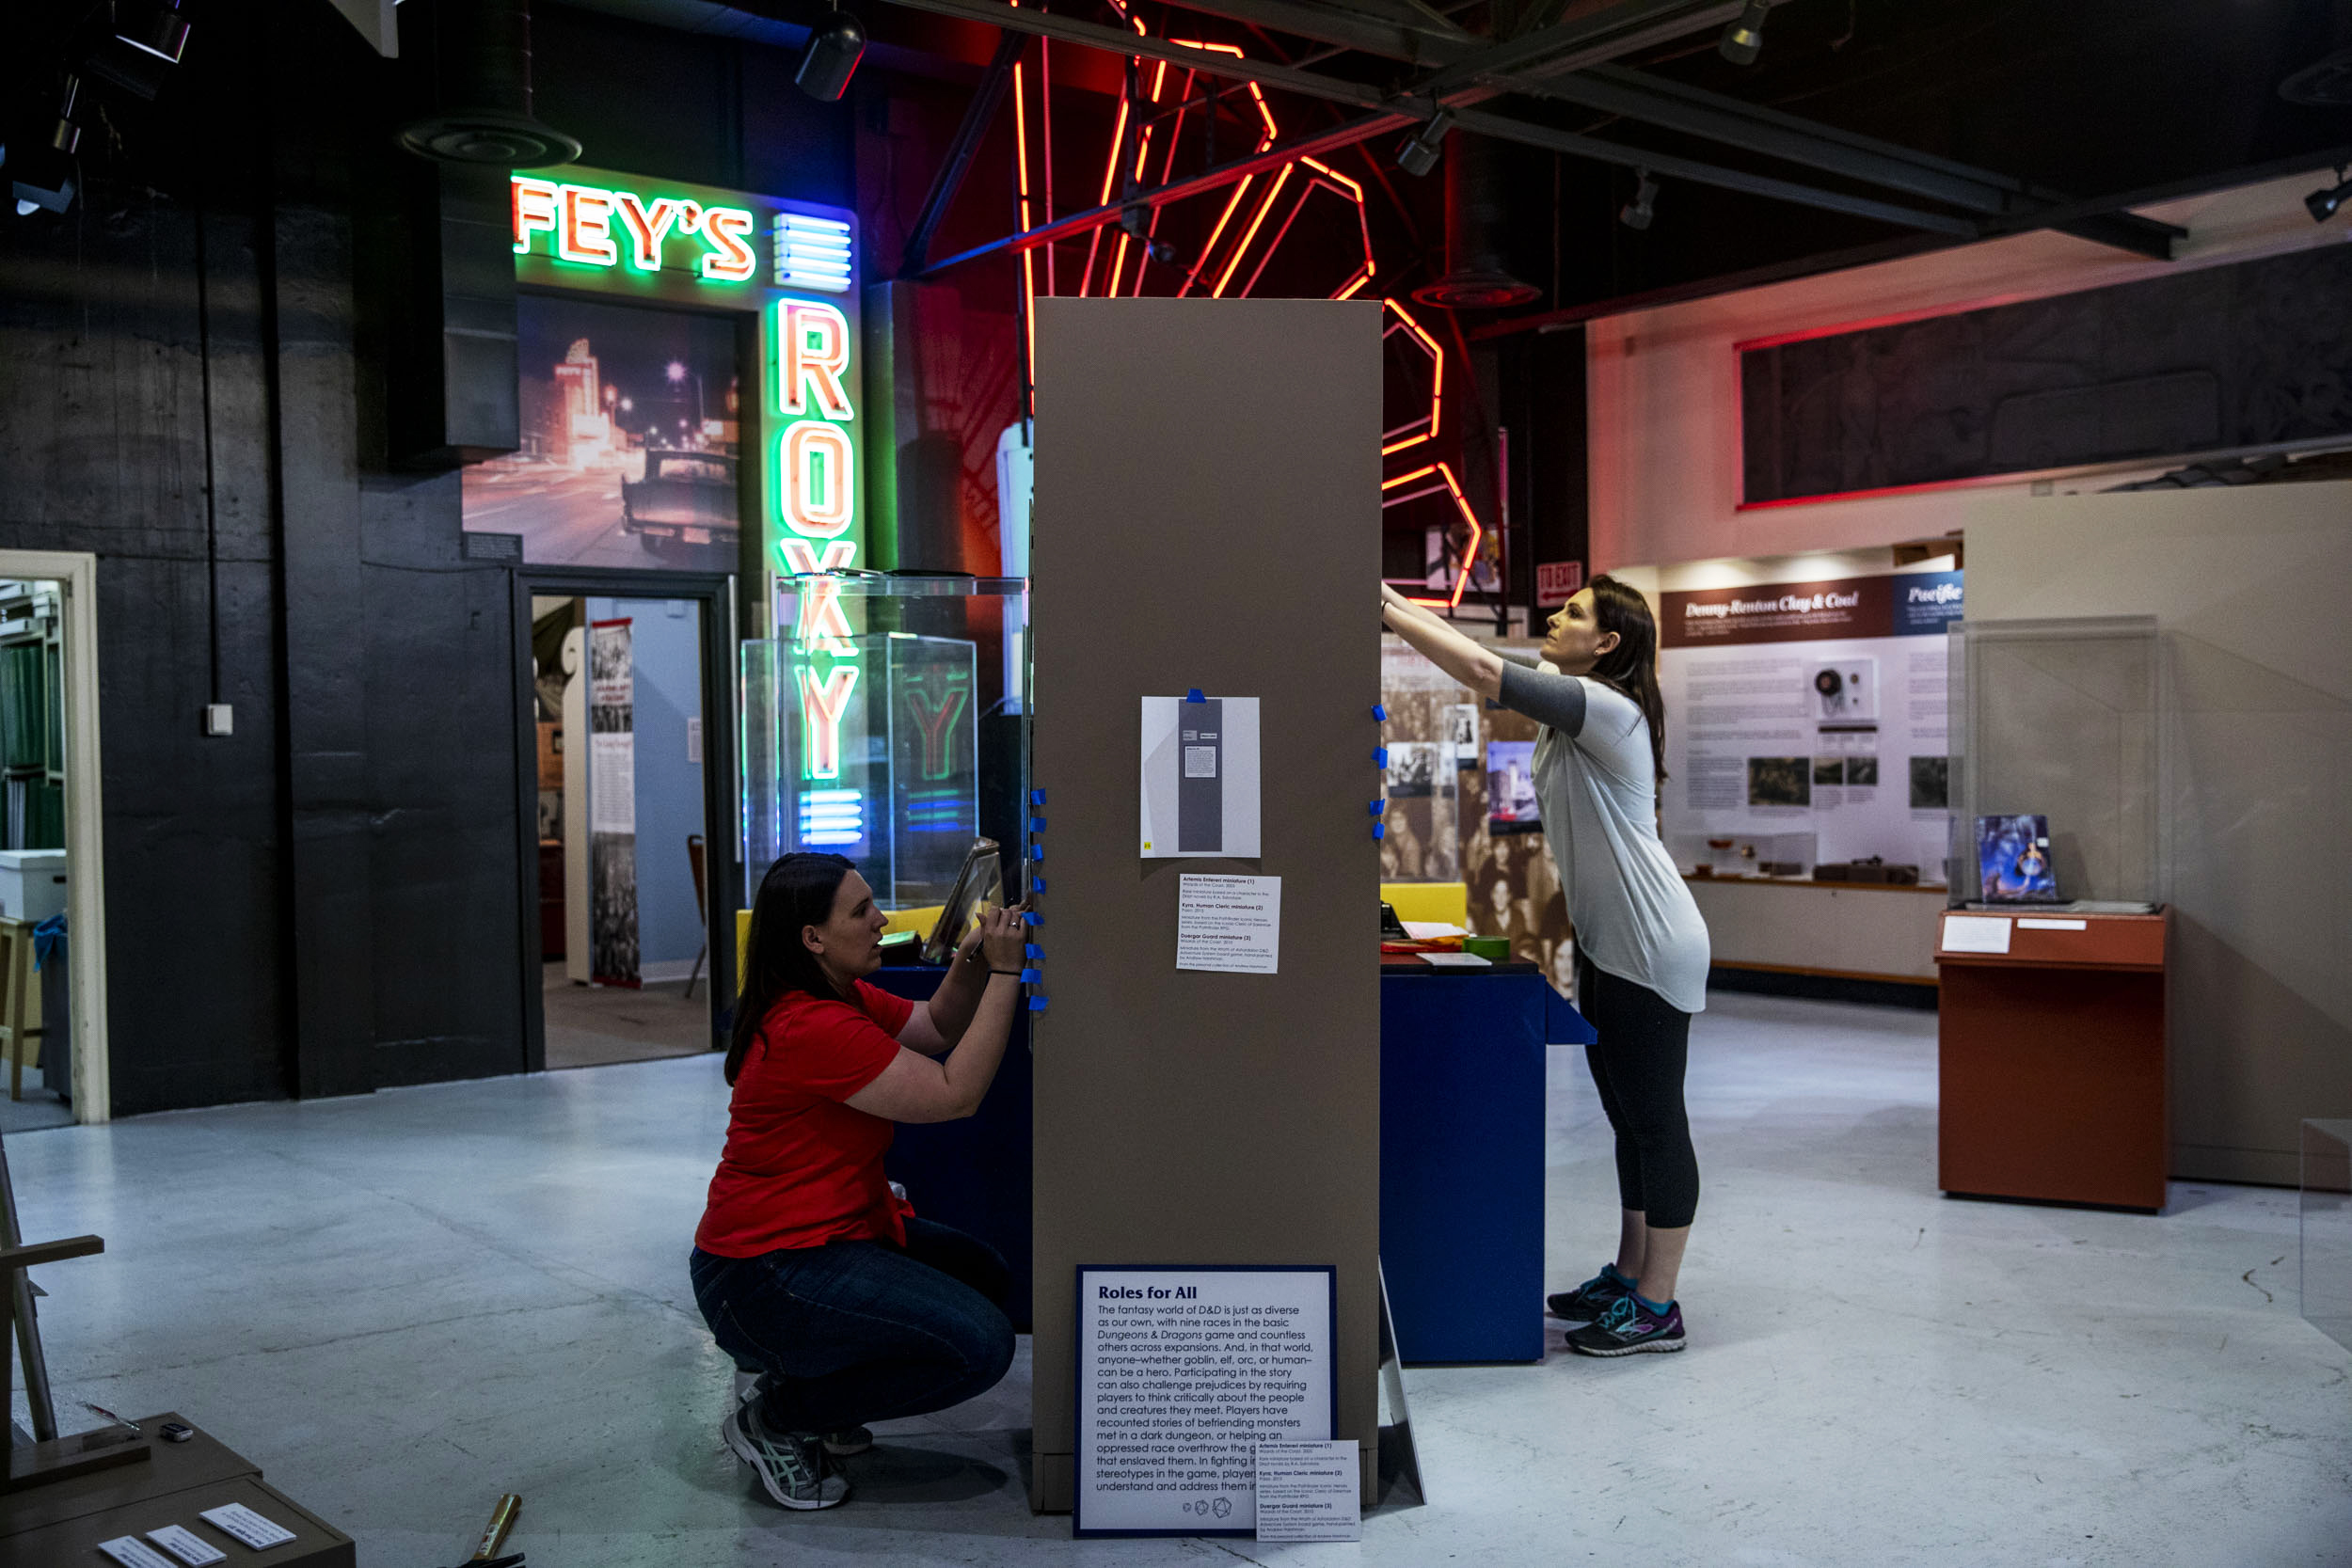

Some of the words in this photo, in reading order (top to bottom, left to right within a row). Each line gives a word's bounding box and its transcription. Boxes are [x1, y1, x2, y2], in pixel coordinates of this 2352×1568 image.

[778, 297, 860, 780] ROXY
[1556, 564, 1579, 587] EXIT
[1779, 594, 1811, 613] Clay
[1825, 591, 1859, 608] Coal
[1099, 1286, 1143, 1299] Roles
[1147, 1286, 1172, 1299] for
[1175, 1286, 1197, 1299] All
[1098, 1305, 1116, 1314] The
[1118, 1305, 1154, 1316] fantasy
[1156, 1305, 1184, 1315] world
[1186, 1305, 1197, 1315] of
[1198, 1305, 1222, 1315] D&D
[1224, 1305, 1231, 1315] is
[1232, 1305, 1249, 1316] just
[1264, 1305, 1300, 1315] diverse
[1156, 1317, 1178, 1327] with
[1179, 1318, 1201, 1327] nine
[1233, 1318, 1242, 1327] in
[1244, 1318, 1261, 1327] the
[1263, 1318, 1289, 1327] basic
[1097, 1330, 1148, 1341] Dungeons
[1150, 1330, 1158, 1339] &
[1160, 1330, 1202, 1341] Dragons
[1204, 1332, 1235, 1341] game
[1237, 1330, 1258, 1339] and
[1260, 1330, 1306, 1339] countless
[1097, 1342, 1128, 1352] others
[1164, 1342, 1221, 1353] expansions.
[1223, 1343, 1247, 1352] And,
[1250, 1343, 1259, 1351] in
[1261, 1343, 1281, 1352] that
[1283, 1343, 1313, 1352] world,
[1184, 1355, 1217, 1366] goblin,
[1220, 1355, 1235, 1365] elf,
[1120, 1368, 1134, 1377] be
[1146, 1368, 1172, 1377] hero.
[1174, 1367, 1237, 1379] Participating
[1239, 1368, 1248, 1377] in
[1250, 1368, 1267, 1377] the
[1269, 1368, 1292, 1379] story
[1120, 1380, 1140, 1390] also
[1142, 1380, 1193, 1391] challenge
[1195, 1380, 1247, 1391] prejudices
[1248, 1380, 1262, 1391] by
[1263, 1380, 1307, 1391] requiring
[1097, 1393, 1133, 1404] players
[1135, 1393, 1146, 1402] to
[1148, 1392, 1171, 1402] think
[1173, 1392, 1215, 1404] critically
[1216, 1393, 1247, 1402] about
[1250, 1393, 1266, 1402] the
[1268, 1393, 1305, 1404] people
[1097, 1405, 1118, 1414] and
[1120, 1405, 1167, 1415] creatures
[1169, 1405, 1192, 1416] they
[1194, 1405, 1223, 1415] meet.
[1226, 1405, 1260, 1416] Players
[1262, 1405, 1288, 1415] have
[1096, 1418, 1150, 1427] recounted
[1152, 1418, 1183, 1427] stories
[1184, 1417, 1195, 1427] of
[1197, 1418, 1255, 1429] befriending
[1257, 1418, 1301, 1427] monsters
[1097, 1431, 1117, 1440] met
[1119, 1431, 1128, 1440] in
[1140, 1431, 1163, 1440] dark
[1165, 1431, 1214, 1442] dungeon,
[1229, 1430, 1267, 1442] helping
[1096, 1443, 1149, 1454] oppressed
[1177, 1443, 1228, 1453] overthrow
[1230, 1443, 1247, 1453] the
[1097, 1456, 1117, 1465] that
[1119, 1456, 1165, 1465] enslaved
[1168, 1456, 1197, 1465] them.
[1199, 1456, 1208, 1465] In
[1210, 1456, 1248, 1467] fighting
[1096, 1469, 1154, 1480] stereotypes
[1156, 1468, 1165, 1478] in
[1168, 1469, 1184, 1478] the
[1186, 1471, 1220, 1480] game,
[1096, 1481, 1154, 1491] understand
[1156, 1482, 1177, 1491] and
[1179, 1481, 1218, 1491] address
[1221, 1482, 1247, 1491] them
